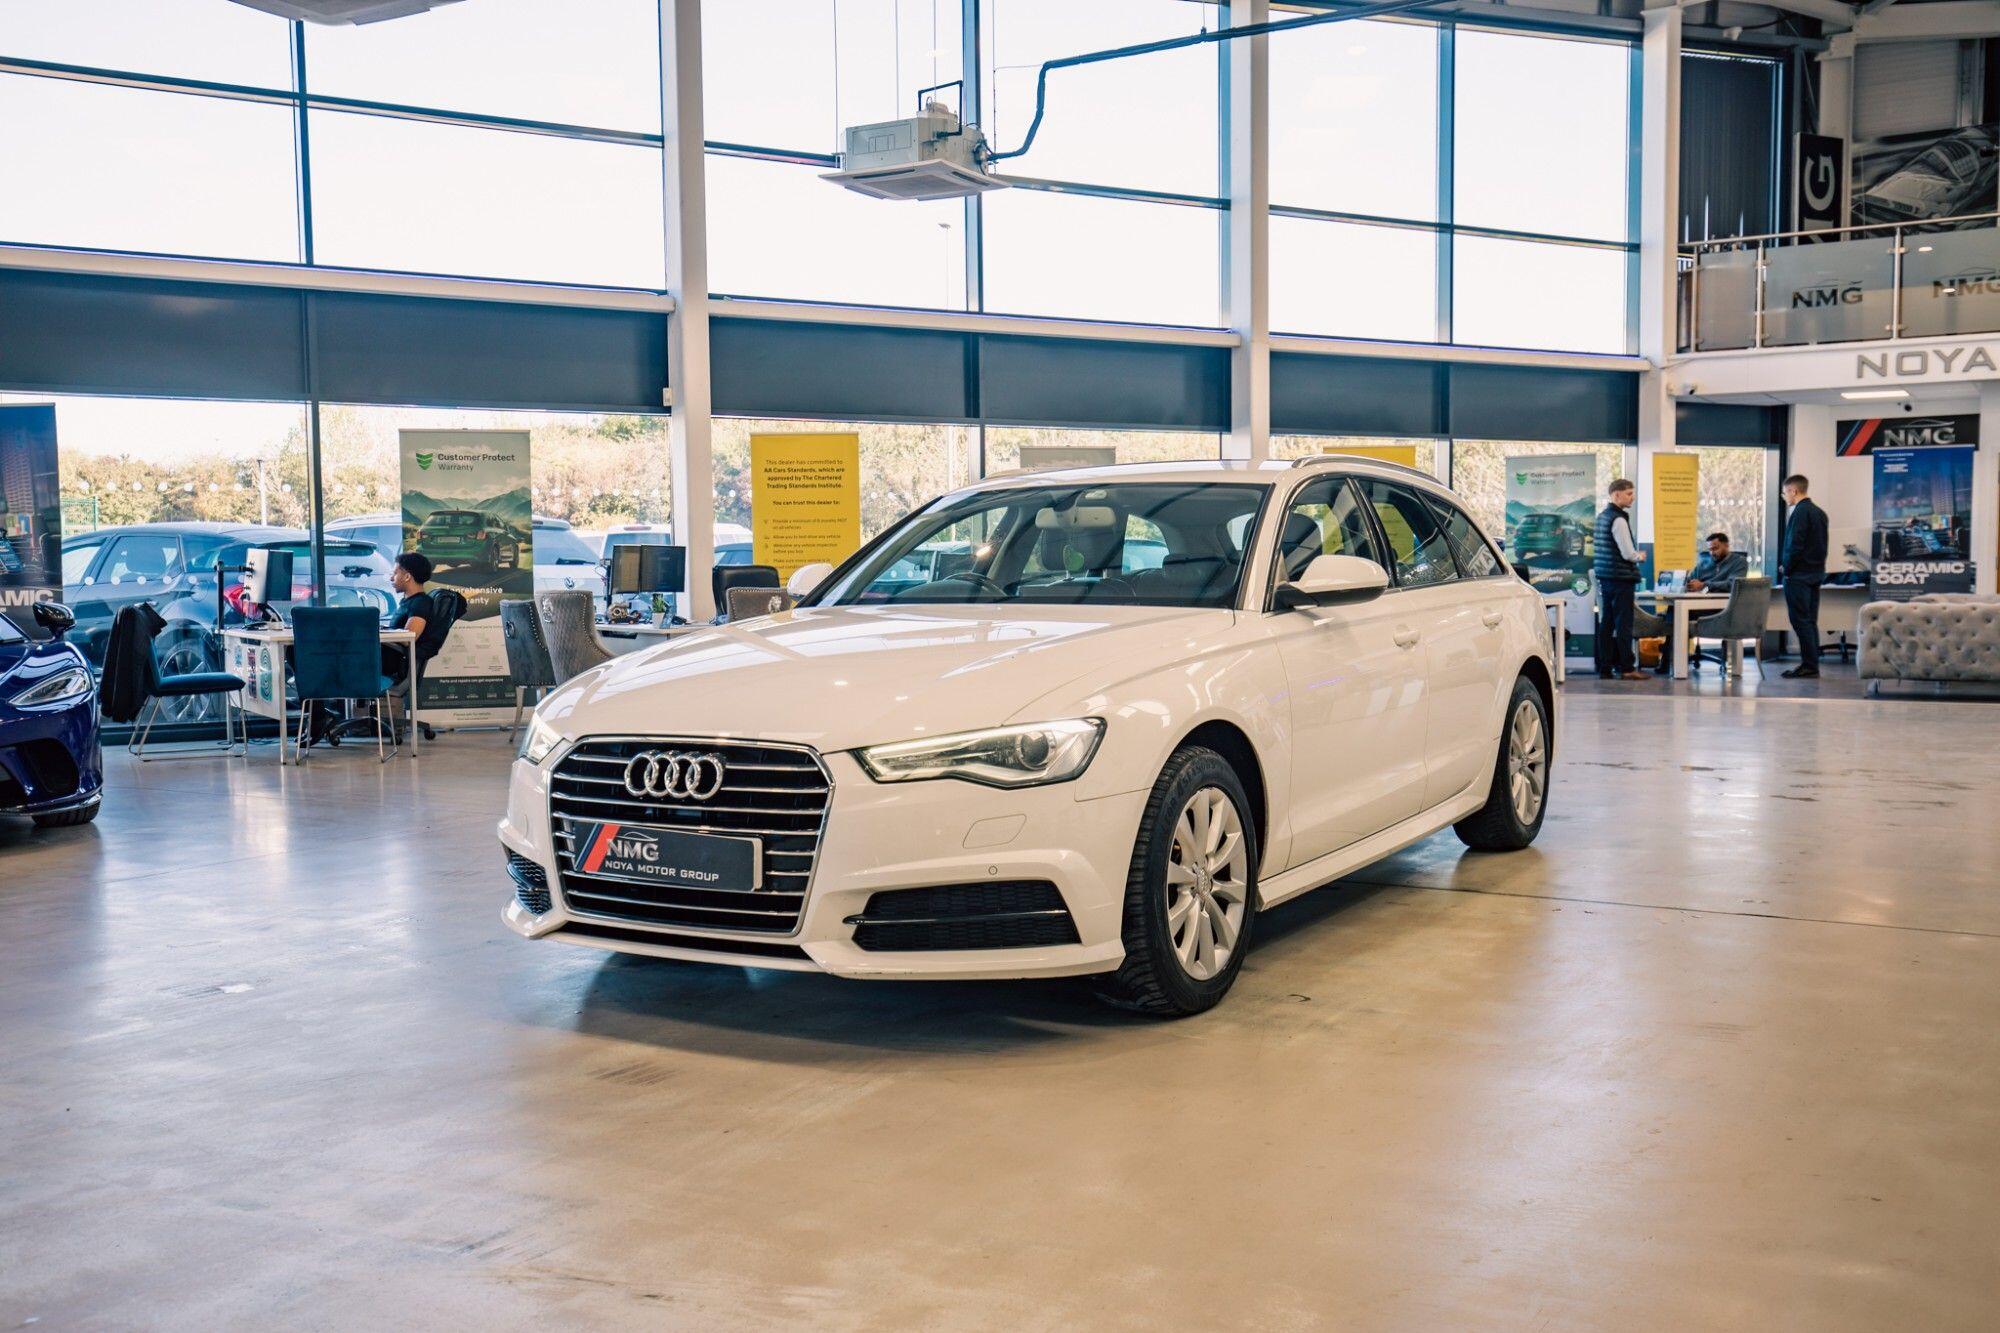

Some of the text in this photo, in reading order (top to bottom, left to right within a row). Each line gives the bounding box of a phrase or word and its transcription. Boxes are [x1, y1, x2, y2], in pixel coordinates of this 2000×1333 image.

[1792, 287, 1863, 309] NMG
[1857, 347, 1997, 378] NOYA
[1884, 427, 1956, 447] NMG
[482, 453, 515, 461] Protect
[438, 463, 474, 472] Warranty
[1876, 562, 1965, 574] CERAMIC
[1876, 573, 1930, 584] COAT
[607, 838, 659, 861] NMG
[605, 861, 719, 882] NOYA MOTOR GROUP
